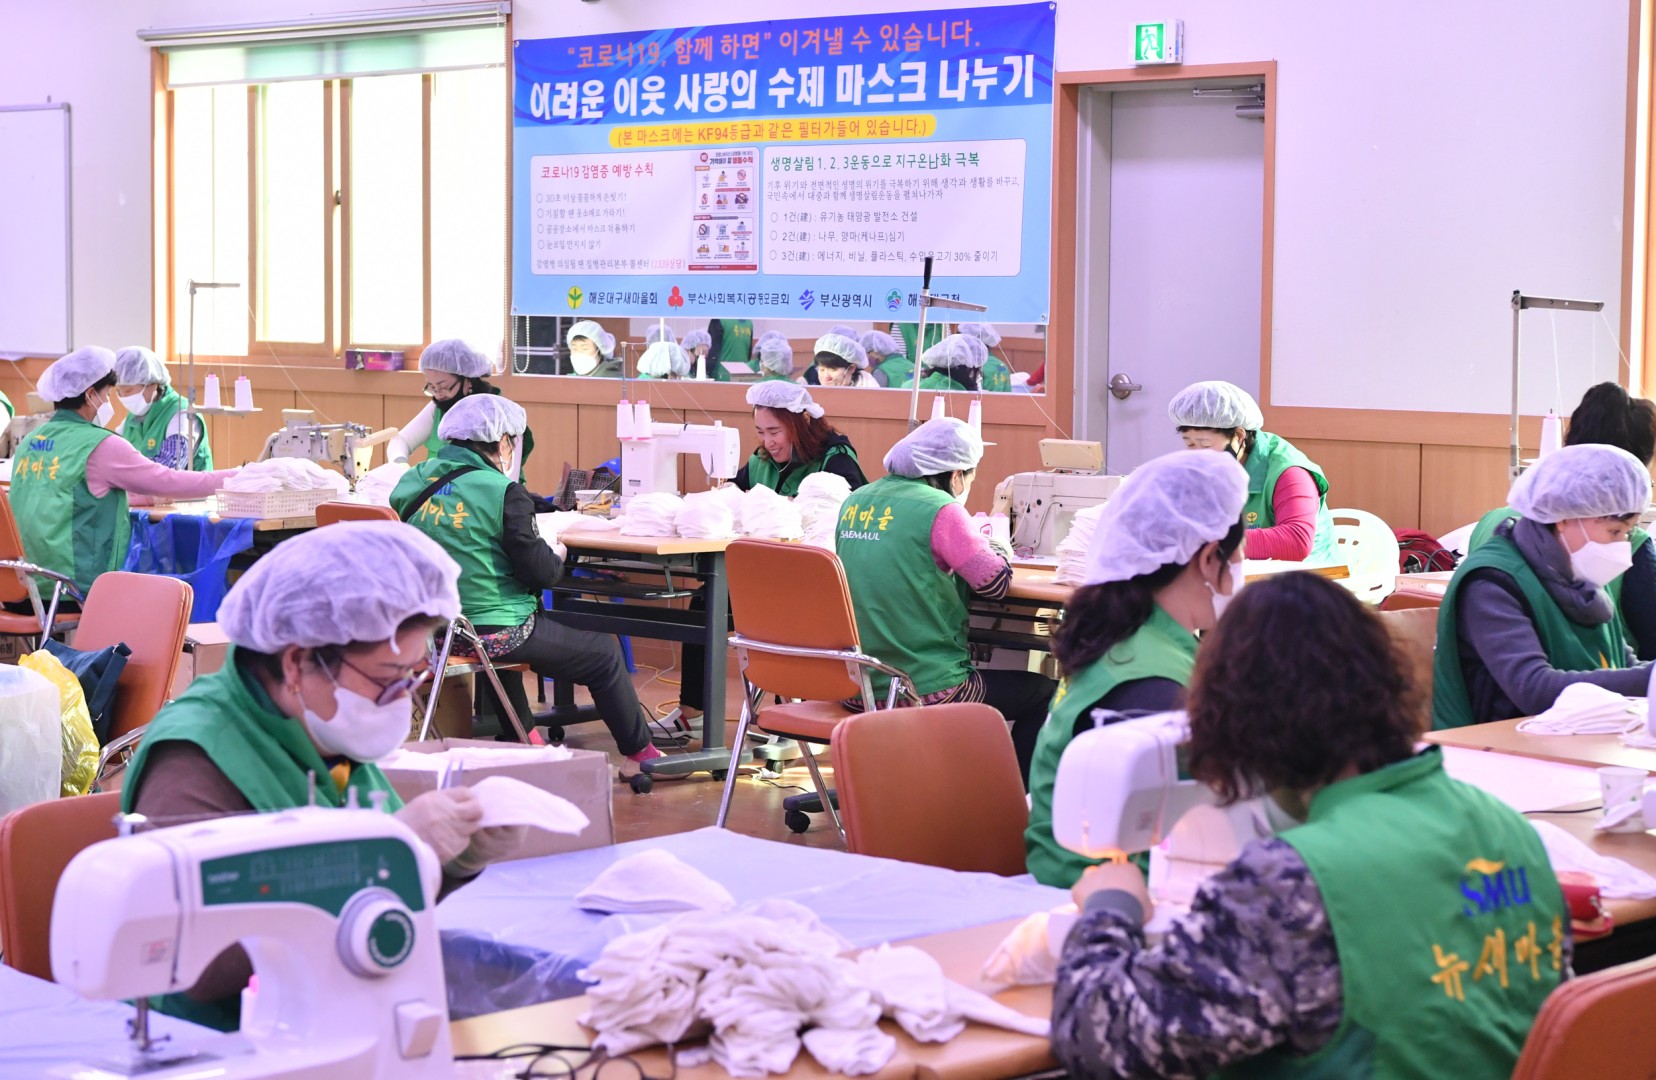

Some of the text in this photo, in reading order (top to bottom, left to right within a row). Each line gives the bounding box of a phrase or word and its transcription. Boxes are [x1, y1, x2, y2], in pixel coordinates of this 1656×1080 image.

[675, 35, 714, 65] 함께
[720, 32, 772, 60] 하면”
[779, 27, 843, 56] 이겨낼
[851, 26, 872, 53] 수
[879, 19, 981, 53] 있습니다.
[530, 54, 1035, 120] 어려운 이웃 사랑의 수제 마스크 나누기
[617, 118, 927, 146] (본 마스크에는 KF94등급과 같은 필터가들어 있습니다.)
[771, 156, 814, 171] 생명살림
[896, 153, 951, 169] 지구온난화
[955, 152, 980, 167] 극복
[541, 162, 654, 179] 코로나19 감염증 예방 수칙
[784, 180, 808, 190] 위기와
[865, 179, 887, 190] 위기를
[889, 179, 920, 189] 극복하기
[922, 178, 938, 188] 위해
[941, 177, 967, 189] 생각과
[996, 176, 1020, 187] 바꾸고,
[563, 193, 576, 203] 이상
[833, 191, 847, 200] 함께
[820, 212, 844, 223] 유기농
[847, 211, 871, 222] 태양광
[873, 211, 898, 222] 발전소
[901, 211, 918, 222] 건설
[587, 224, 606, 234] 마스크
[608, 223, 636, 234] 착용하기
[818, 251, 845, 262] 에너지,
[870, 251, 907, 262] 플라스틱,
[954, 251, 971, 261] 30%
[974, 250, 998, 262] 줄이기
[589, 291, 658, 304] 해운대구새마을회
[688, 292, 790, 305] 부산사회복지공동모금회
[820, 293, 872, 308] 부산광역시
[15, 456, 60, 481] 새마을
[840, 503, 894, 531] 새마을
[840, 530, 880, 540] SAEMAUL
[1459, 865, 1531, 917] SMU
